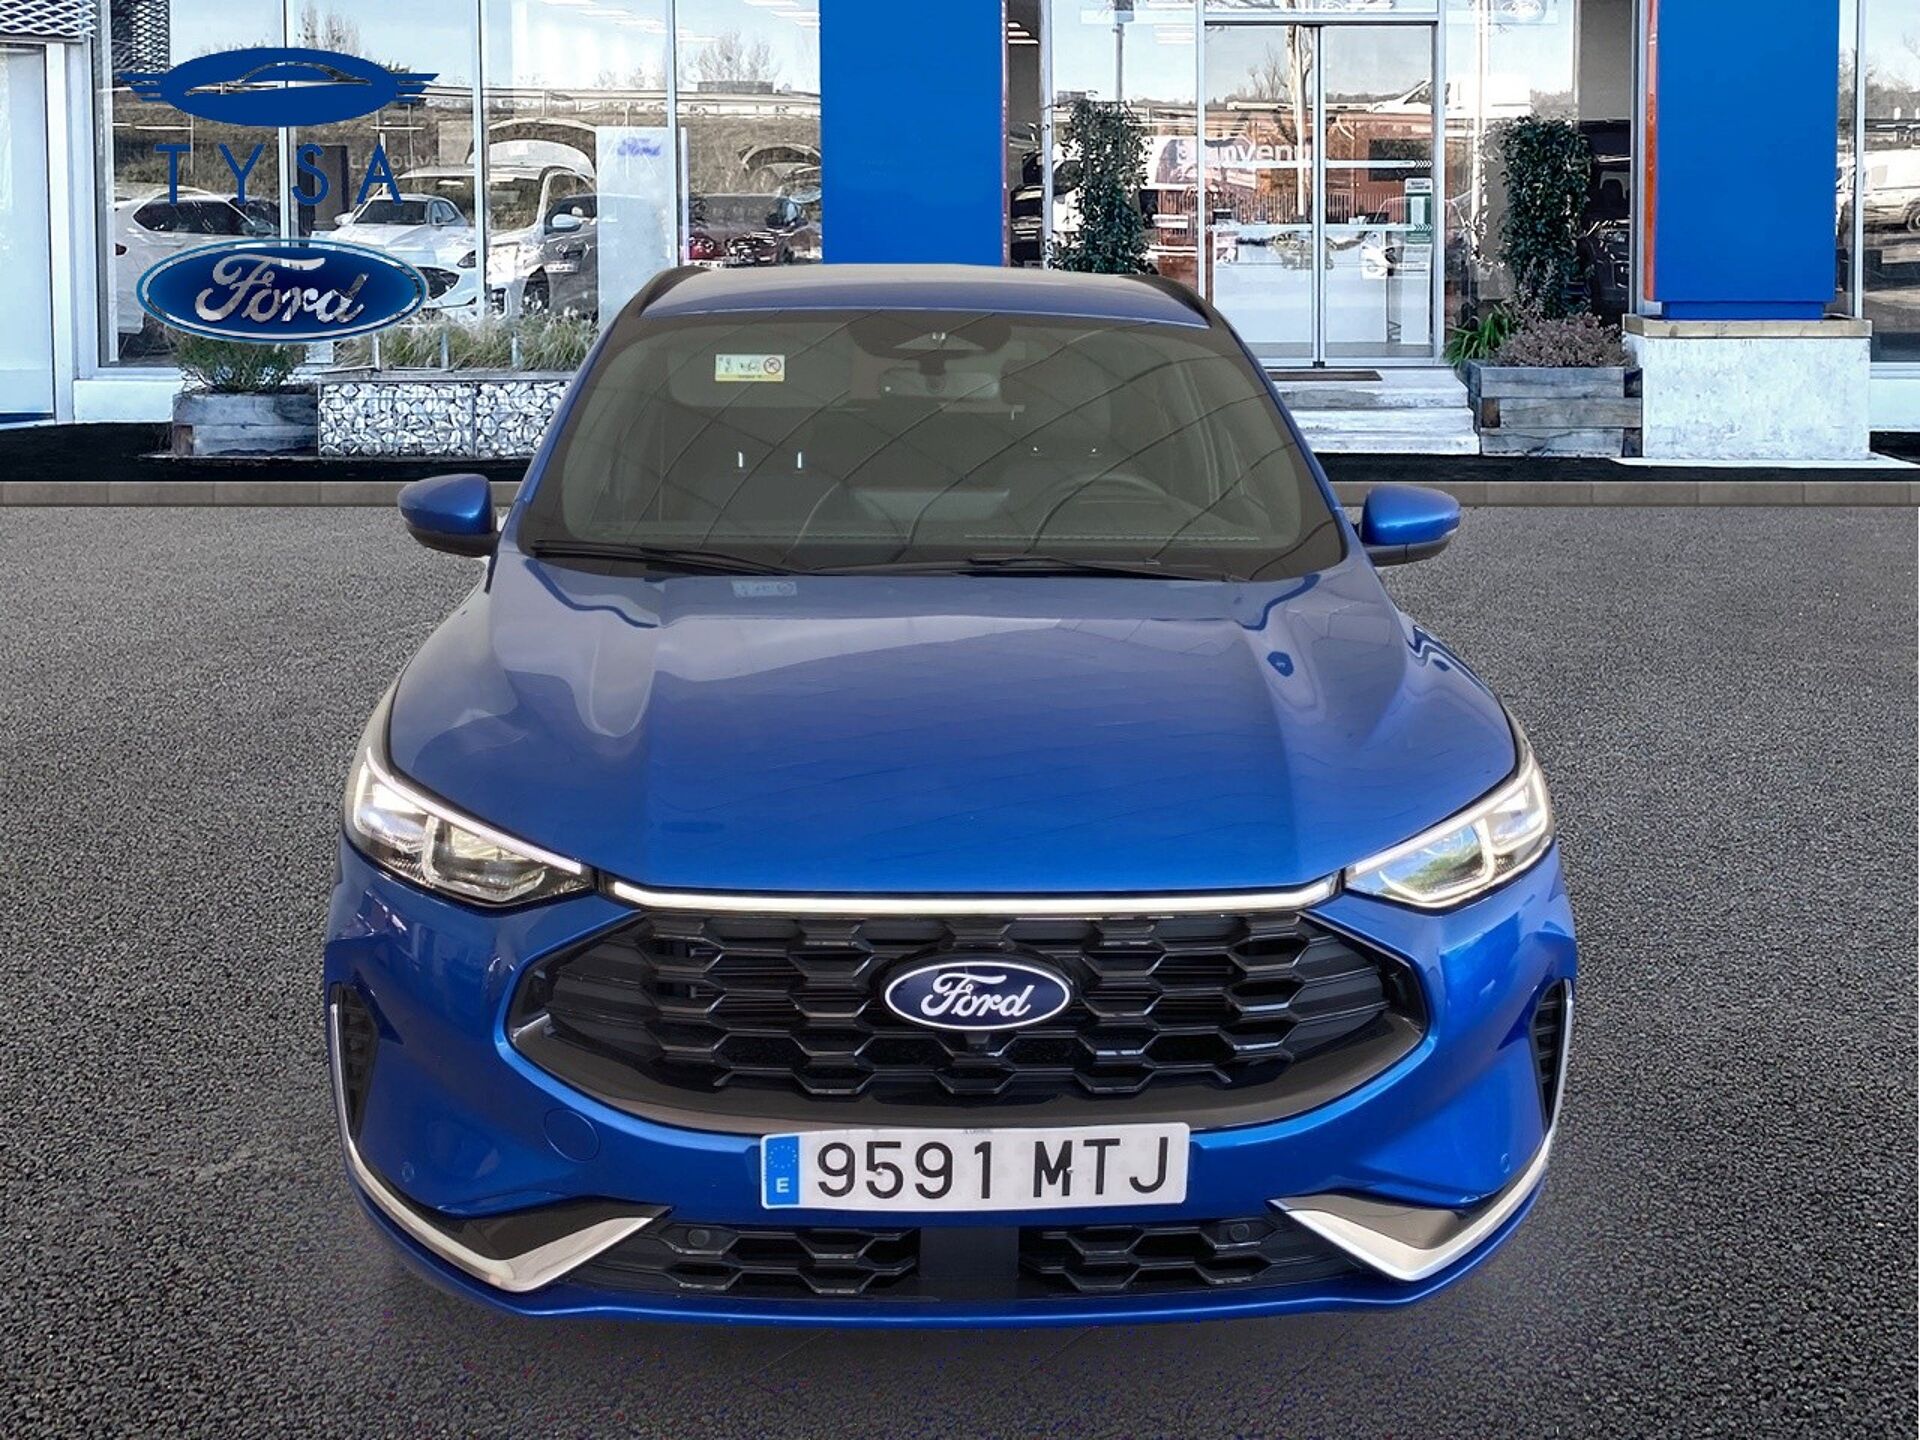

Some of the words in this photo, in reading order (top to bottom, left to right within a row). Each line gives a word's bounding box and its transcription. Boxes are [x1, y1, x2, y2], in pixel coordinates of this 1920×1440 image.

[920, 972, 1036, 1017] Ford
[776, 1177, 789, 1194] E
[817, 1140, 991, 1200] 9591
[1033, 1136, 1169, 1198] MTJ
